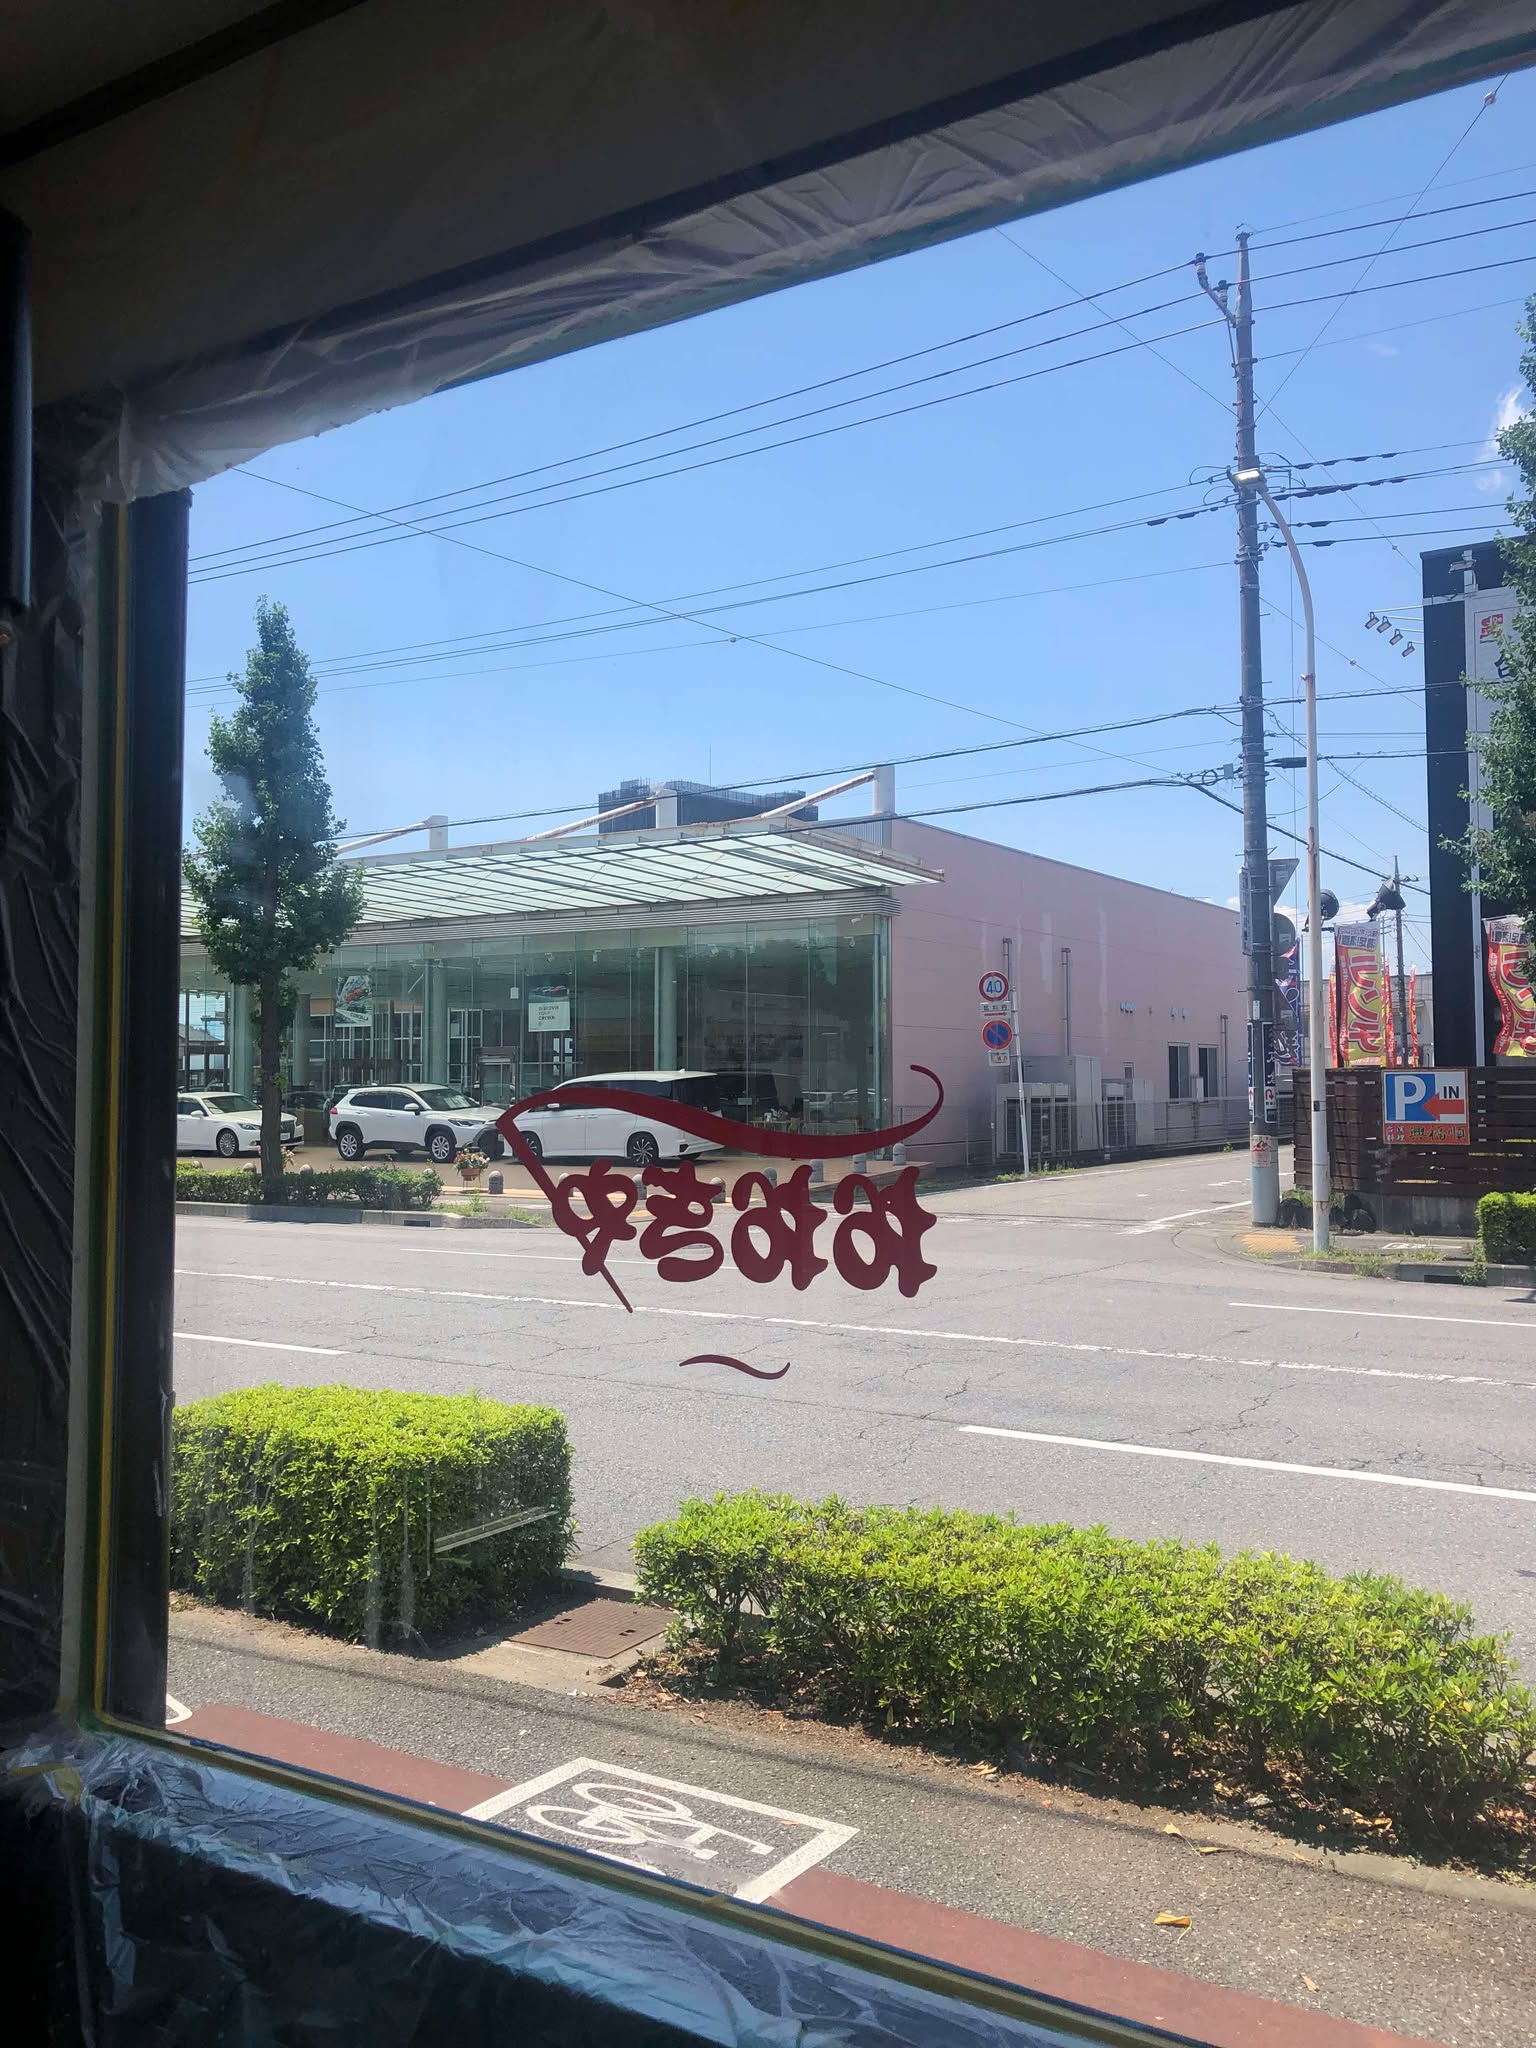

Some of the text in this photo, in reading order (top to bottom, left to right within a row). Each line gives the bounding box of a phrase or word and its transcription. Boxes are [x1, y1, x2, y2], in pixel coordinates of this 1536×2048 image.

[986, 980, 1003, 994] 40
[350, 1012, 369, 1021] COROLLA
[1394, 1074, 1427, 1121] P
[1443, 1085, 1460, 1099] IN
